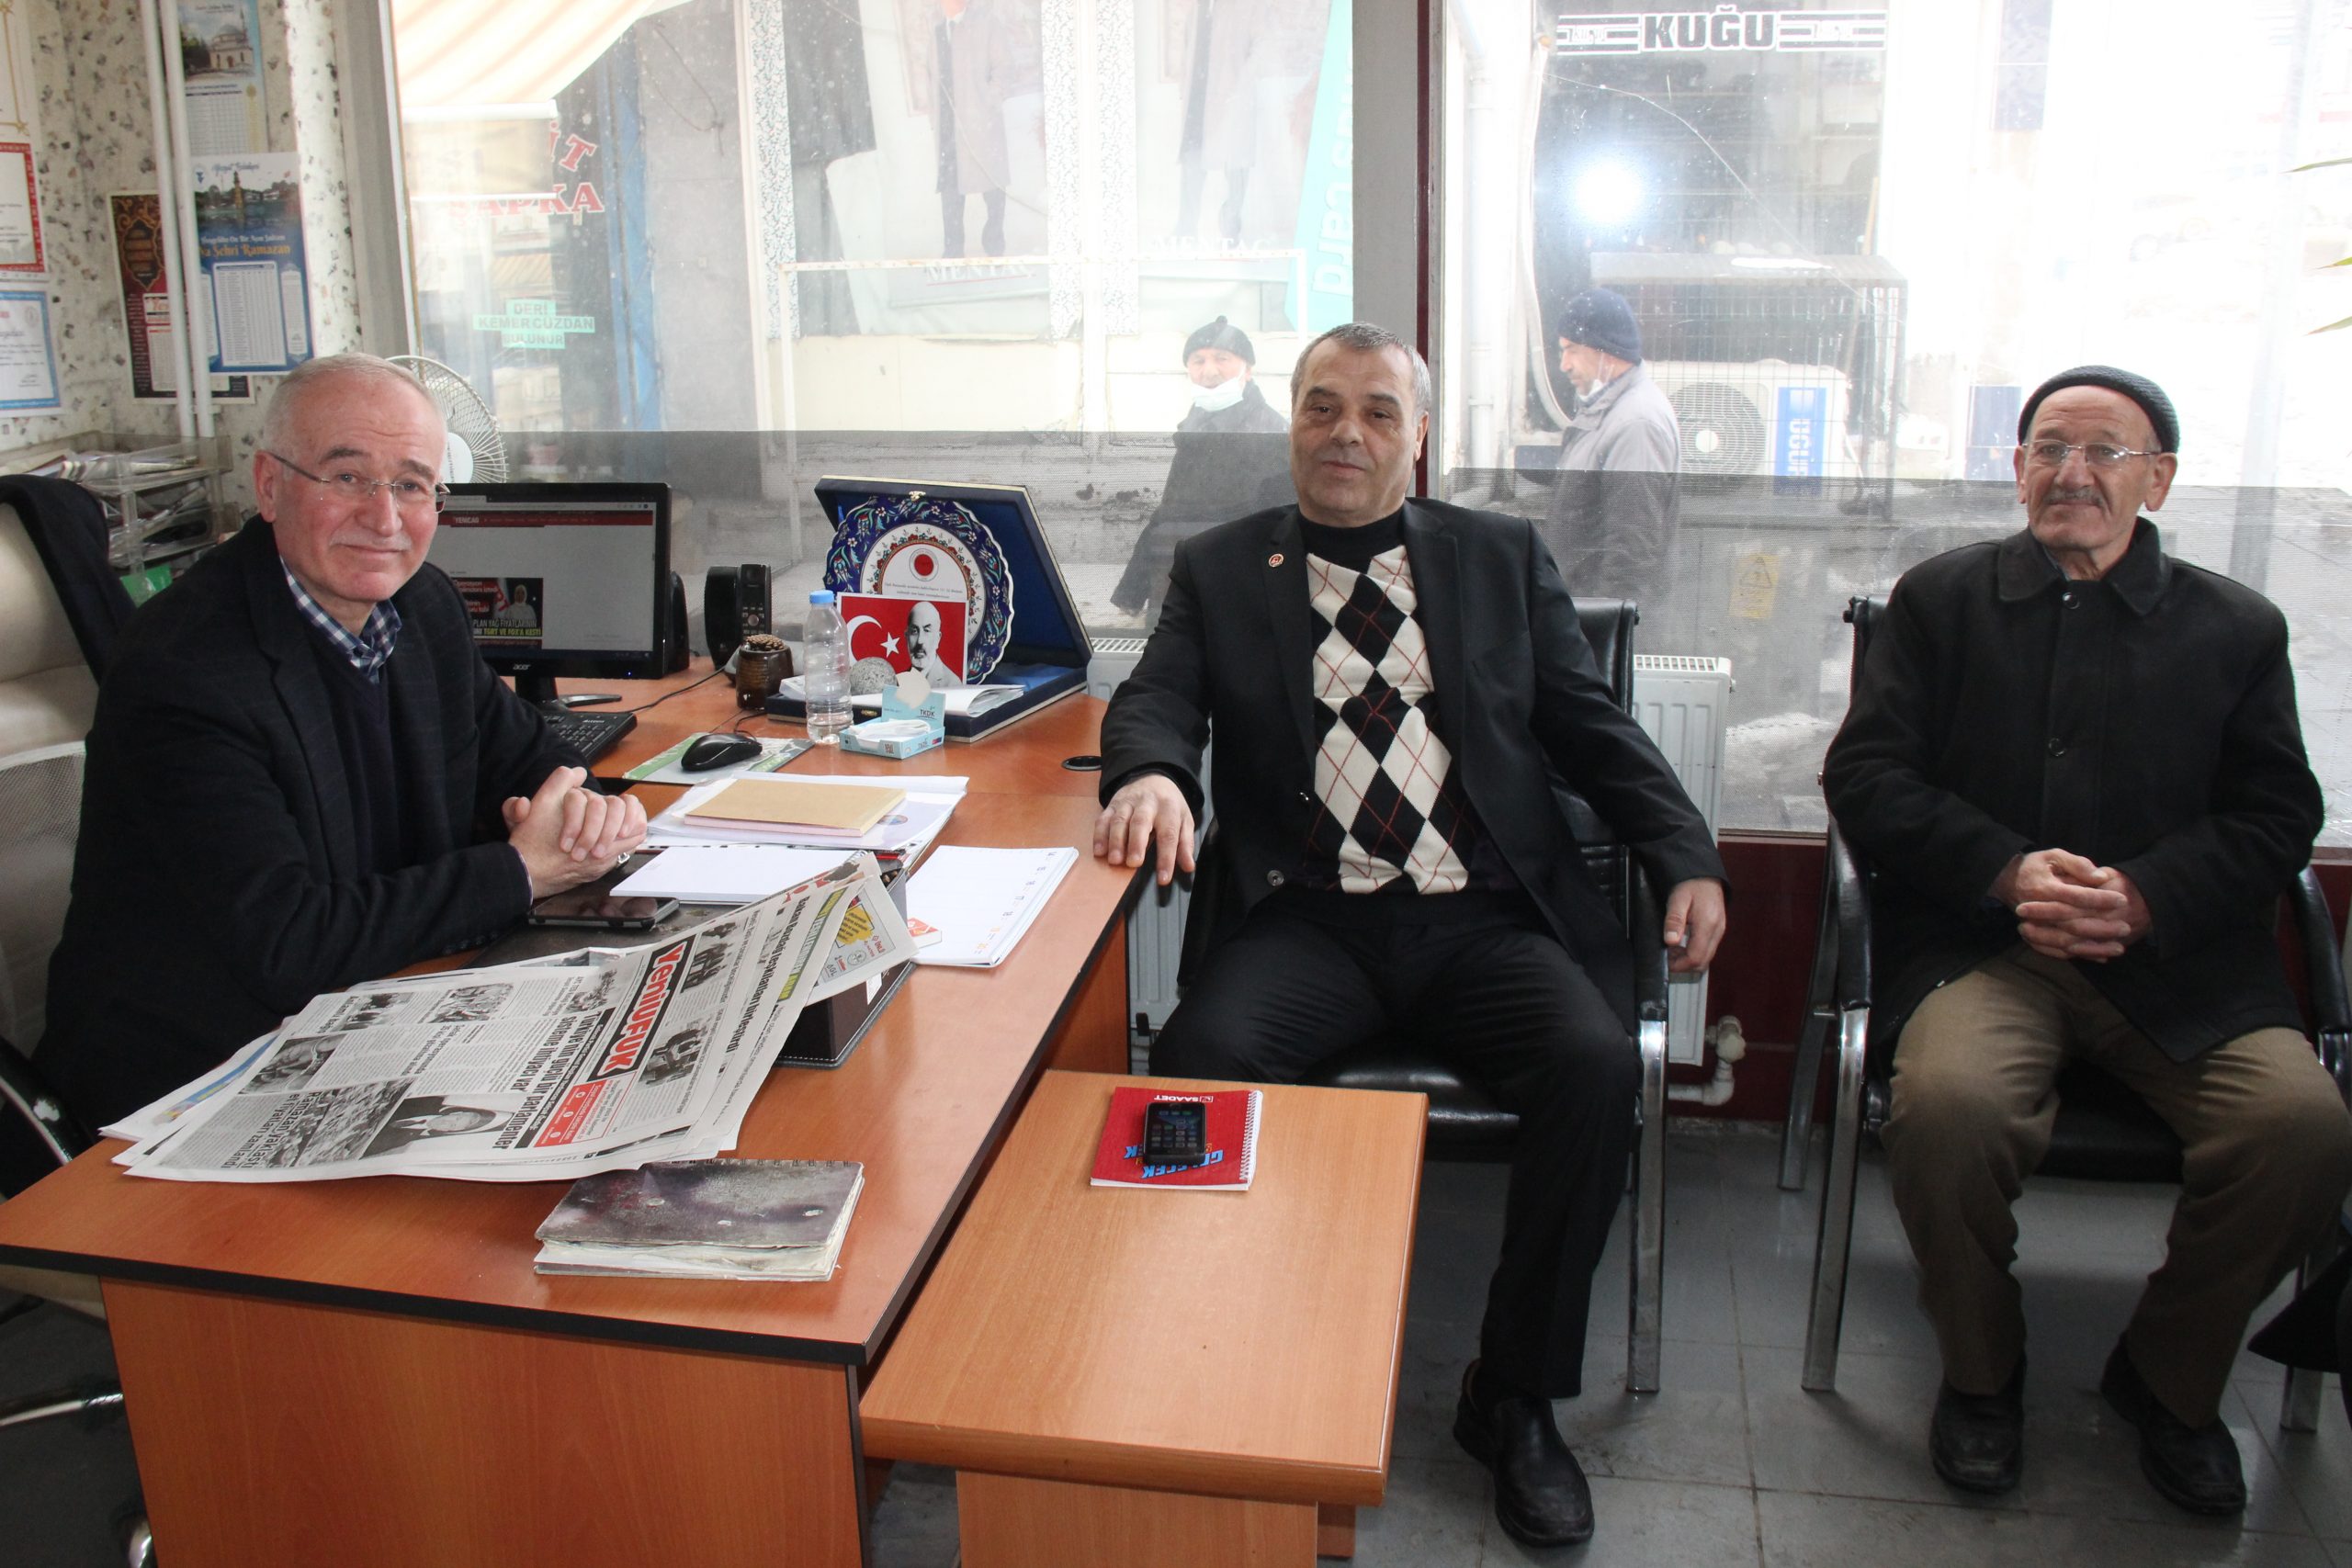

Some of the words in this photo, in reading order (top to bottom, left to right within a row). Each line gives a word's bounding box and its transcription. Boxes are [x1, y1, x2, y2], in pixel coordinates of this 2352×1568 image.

[1645, 5, 1779, 51] KUĞU
[479, 317, 529, 329] KEMER
[532, 316, 594, 330] CÜZDAN
[513, 662, 532, 671] acer
[748, 952, 782, 1005] teşkilatları
[540, 1014, 582, 1048] sisteme
[724, 1002, 760, 1053] birleştirdi
[516, 1044, 560, 1077] ihtiyacı
[536, 1056, 574, 1082] güçlü
[284, 1092, 304, 1102] et
[529, 1080, 558, 1095] bir
[1155, 1094, 1199, 1102] SAADET
[254, 1101, 297, 1134] fiyatları
[274, 1089, 324, 1132] Ramazan
[490, 1094, 548, 1150] parlamenter
[218, 1133, 266, 1168] zamlandı
